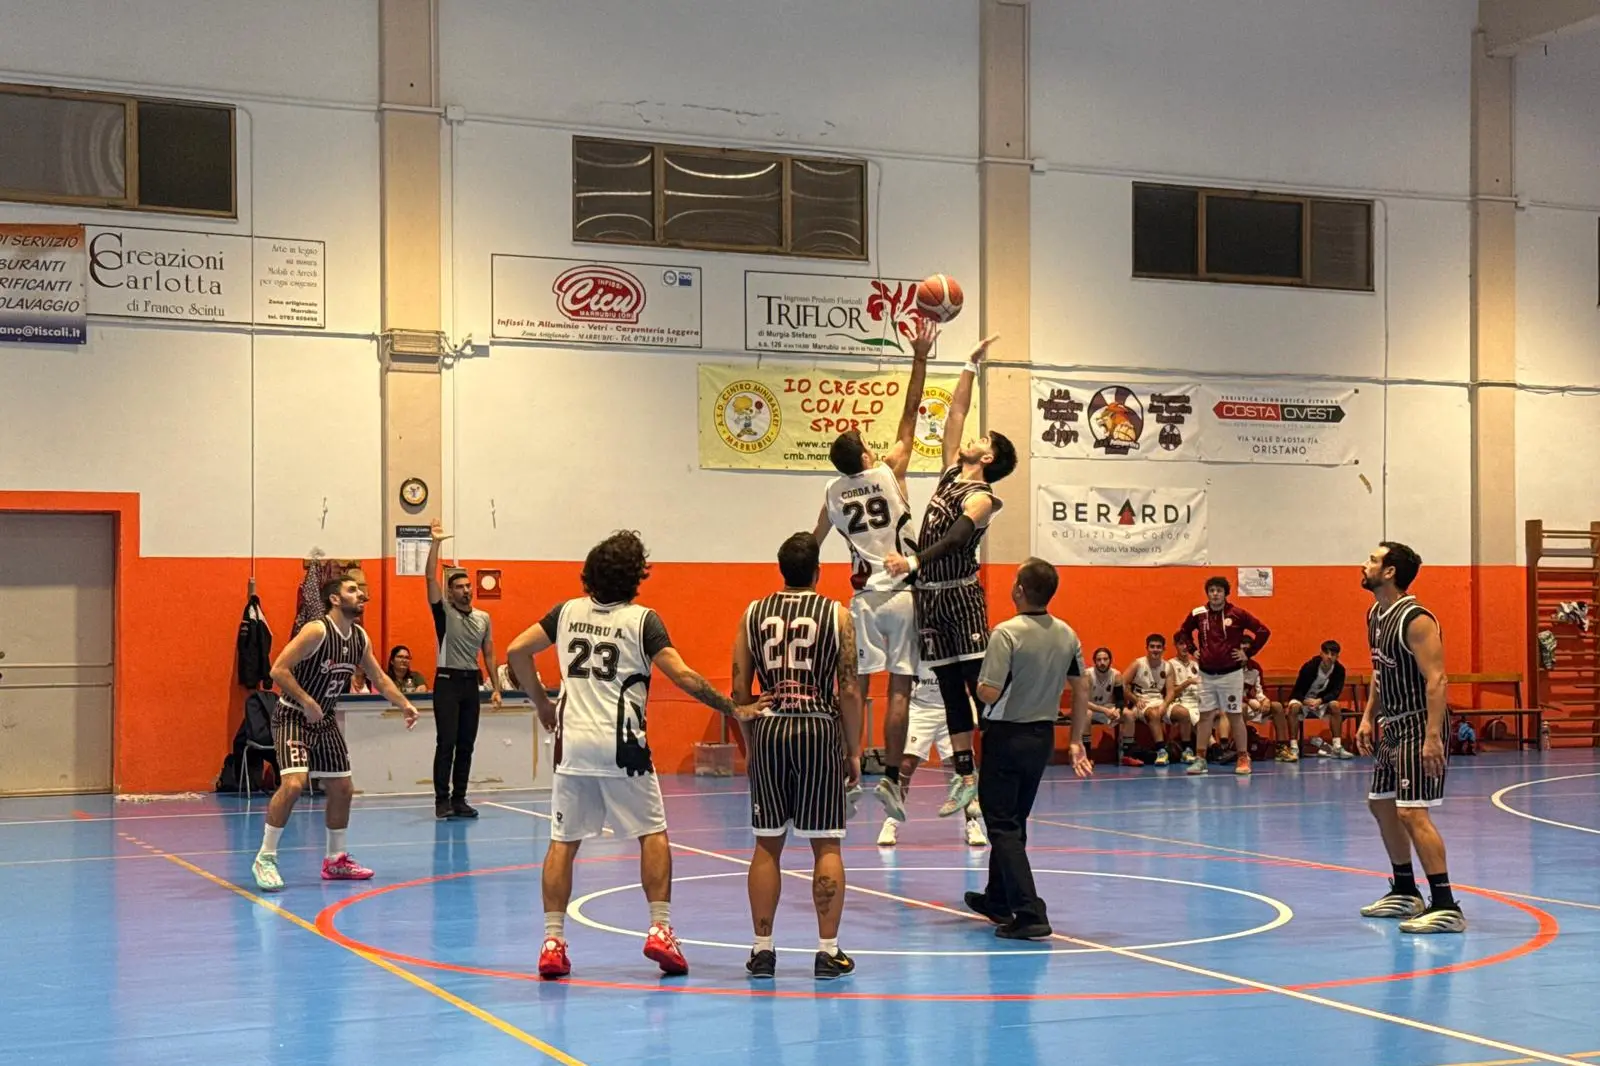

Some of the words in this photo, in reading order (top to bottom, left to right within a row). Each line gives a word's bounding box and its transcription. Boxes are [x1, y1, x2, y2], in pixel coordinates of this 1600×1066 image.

[11, 235, 78, 248] SERVIZIO
[89, 232, 225, 271] Creazioni
[0, 259, 66, 272] BURANTI
[89, 250, 223, 295] Carlotta
[0, 277, 72, 292] RIFICANTI
[562, 278, 631, 313] Cicu
[0, 297, 80, 313] OLAVAGGIO
[127, 298, 140, 312] di
[143, 300, 184, 315] Franco
[188, 303, 225, 316] Scintu
[757, 294, 870, 333] TRIFLOR
[0, 326, 81, 338] ano@tiscali.it
[497, 318, 524, 328] Infissi
[526, 319, 535, 327] In
[537, 320, 579, 329] Alluminio
[587, 323, 609, 331] Vetri
[615, 325, 665, 335] Carpenteria
[667, 327, 699, 336] Leggera
[766, 330, 790, 339] Murgia
[791, 331, 817, 339] Stefano
[722, 383, 751, 401] CENTRO
[784, 378, 811, 394] IO
[819, 379, 899, 396] CRESCO
[801, 398, 845, 414] CON
[852, 399, 884, 415] LO
[1223, 405, 1277, 418] COSTA
[1284, 407, 1336, 420] OVEST
[810, 417, 876, 433] SPORT
[1237, 435, 1249, 443] VIA
[1276, 436, 1305, 444] D'AOSTA
[1252, 445, 1306, 455] ORISTANO
[841, 487, 871, 500] CORDA
[842, 495, 892, 535] 29
[1052, 498, 1191, 525] BERARDI
[614, 627, 626, 639] A.
[760, 615, 817, 670] 22
[567, 637, 621, 682] 23
